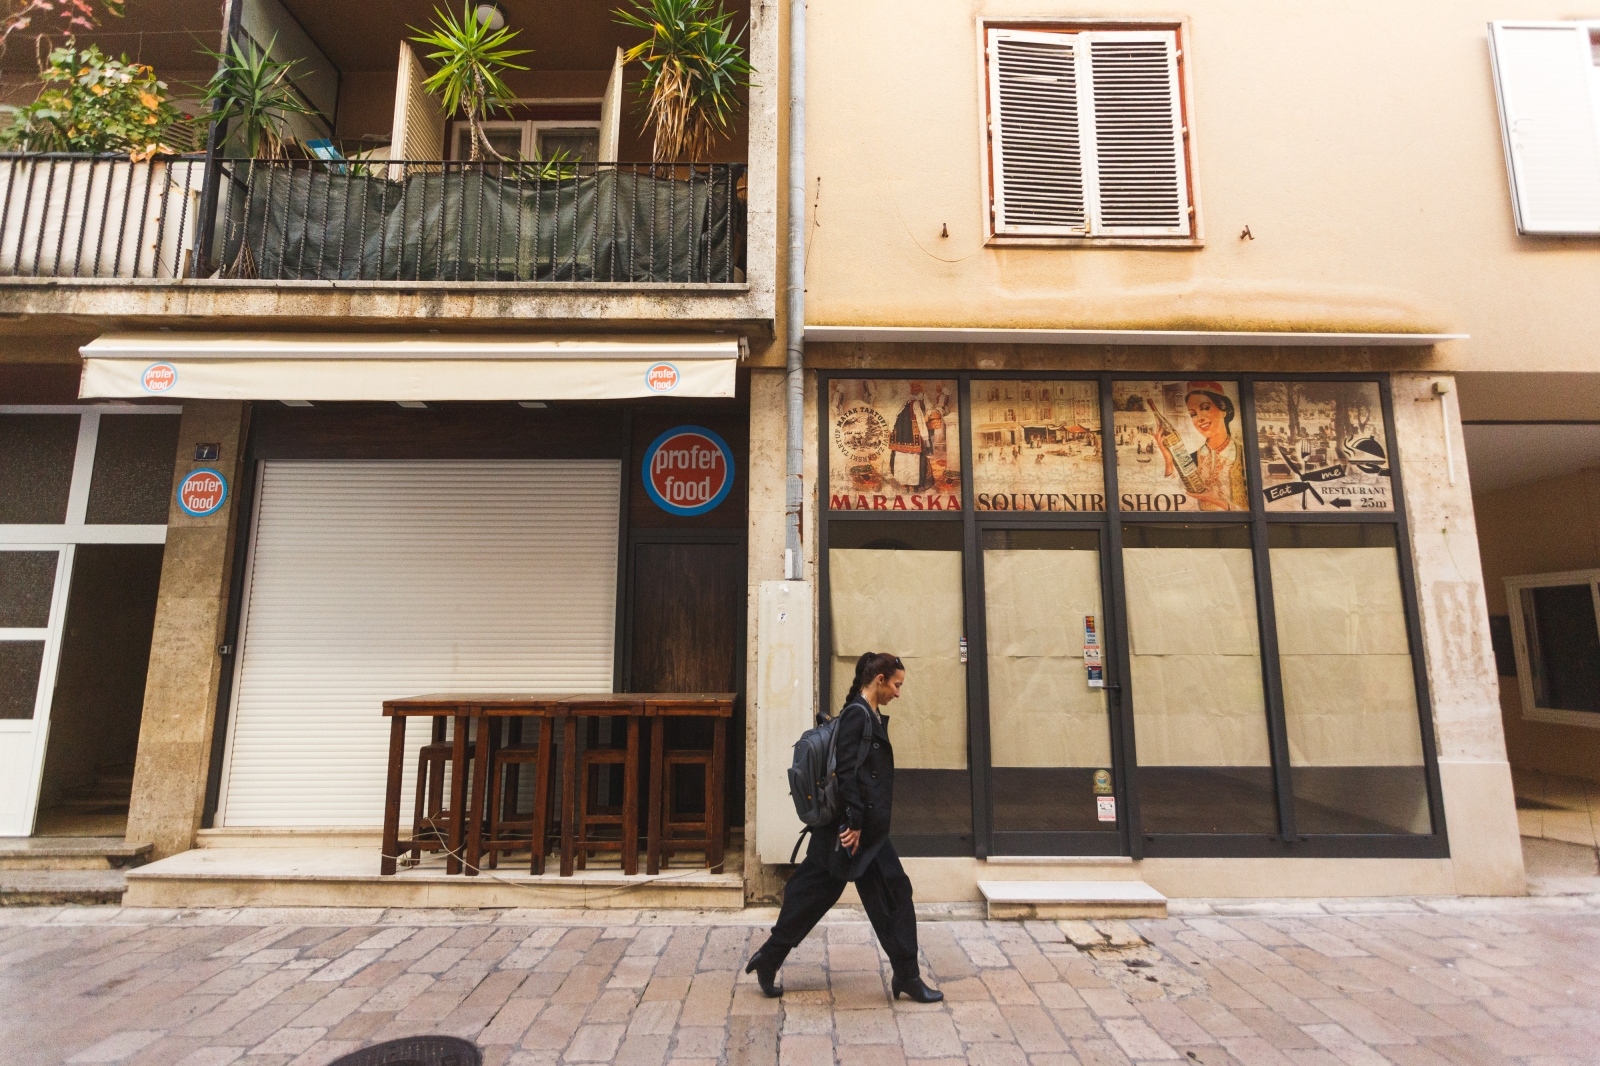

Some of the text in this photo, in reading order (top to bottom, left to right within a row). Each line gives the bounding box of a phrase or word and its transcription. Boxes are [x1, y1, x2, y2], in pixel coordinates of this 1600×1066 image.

[146, 369, 173, 380] profer
[650, 369, 675, 380] profer
[149, 380, 168, 389] food
[653, 380, 671, 389] food
[837, 407, 858, 427] MATAK
[202, 446, 209, 458] 7
[655, 445, 721, 474] profer
[184, 478, 221, 494] profer
[664, 476, 710, 501] food
[1270, 468, 1341, 499] Eat me
[1321, 486, 1385, 495] RESTAURANT
[188, 495, 214, 509] food
[830, 492, 1187, 511] MARASKA SOUVENIR SHOP
[1360, 498, 1387, 508] 25m
